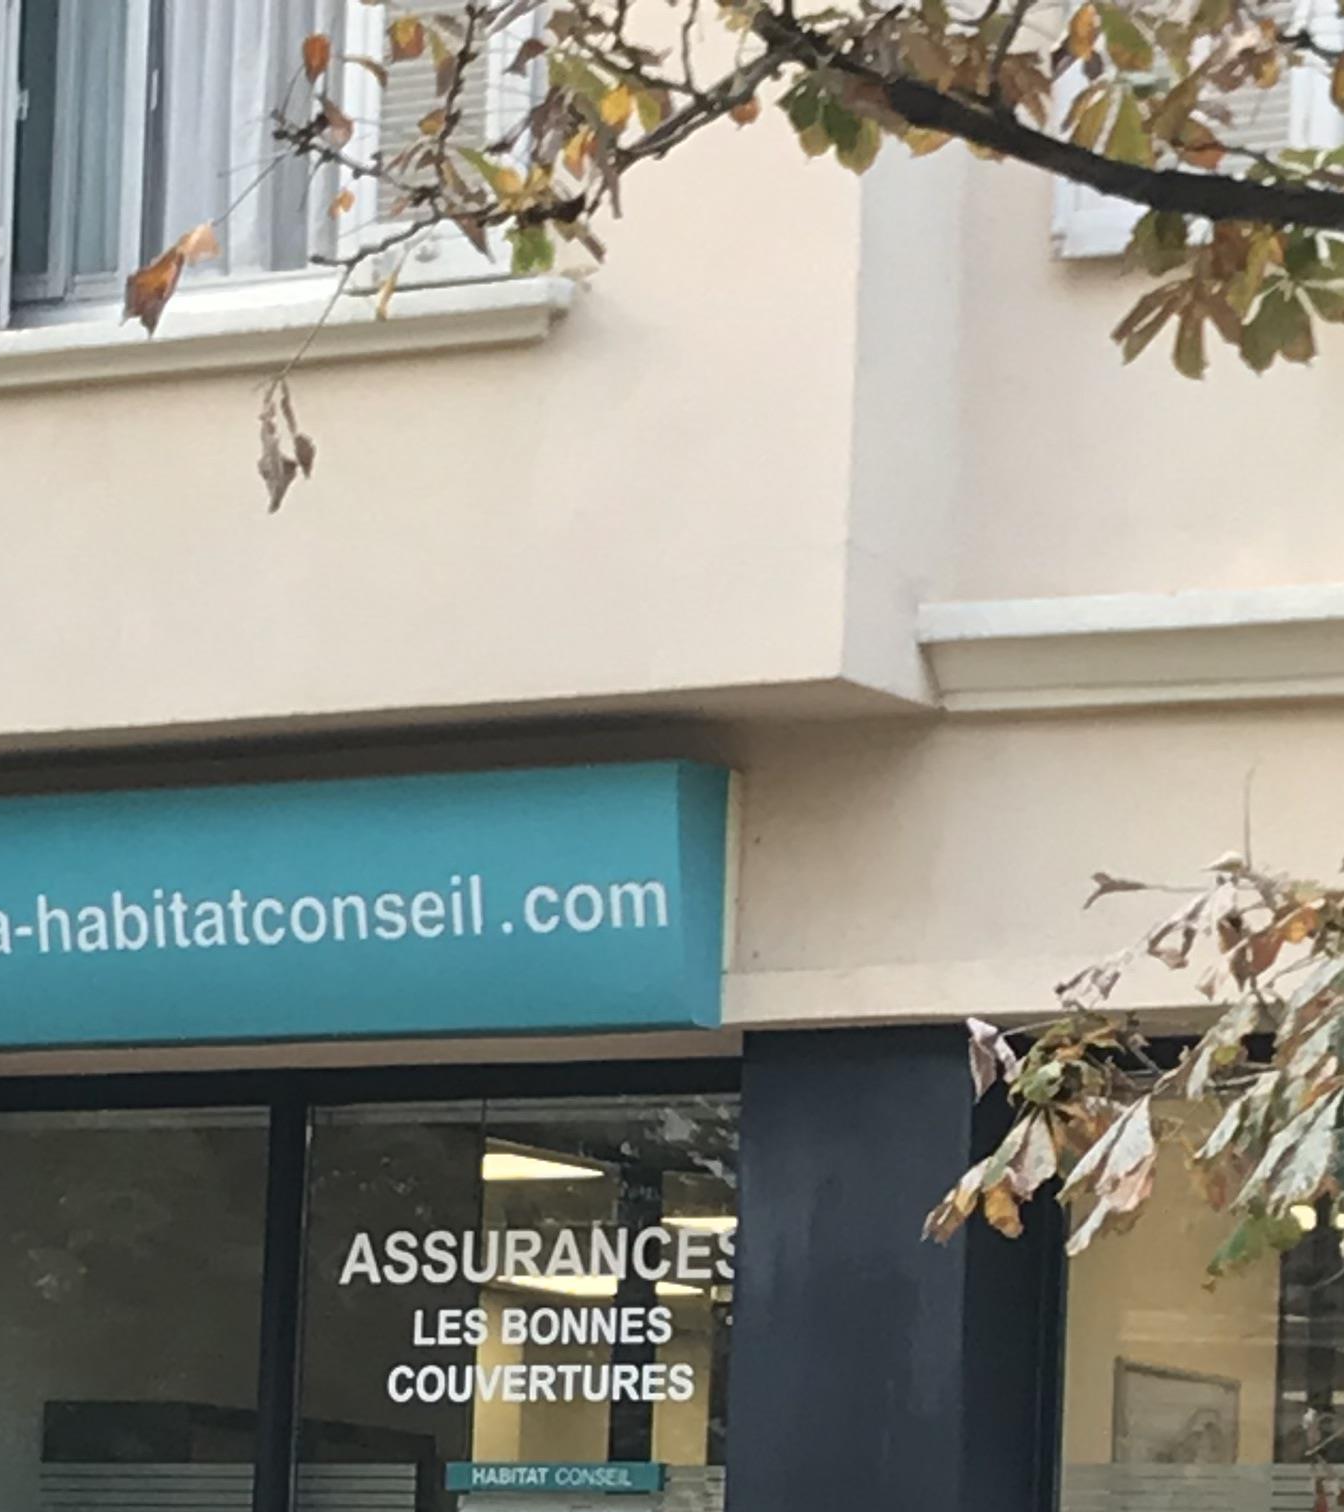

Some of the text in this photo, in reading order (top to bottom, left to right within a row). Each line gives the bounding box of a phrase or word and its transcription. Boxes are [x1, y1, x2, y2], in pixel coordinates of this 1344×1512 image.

[339, 1226, 735, 1285] ASSURANCES
[413, 1306, 672, 1346] LES BONNES
[387, 1363, 694, 1403] COUVERTURES
[471, 1467, 632, 1487] HABITAT CONSEIL
